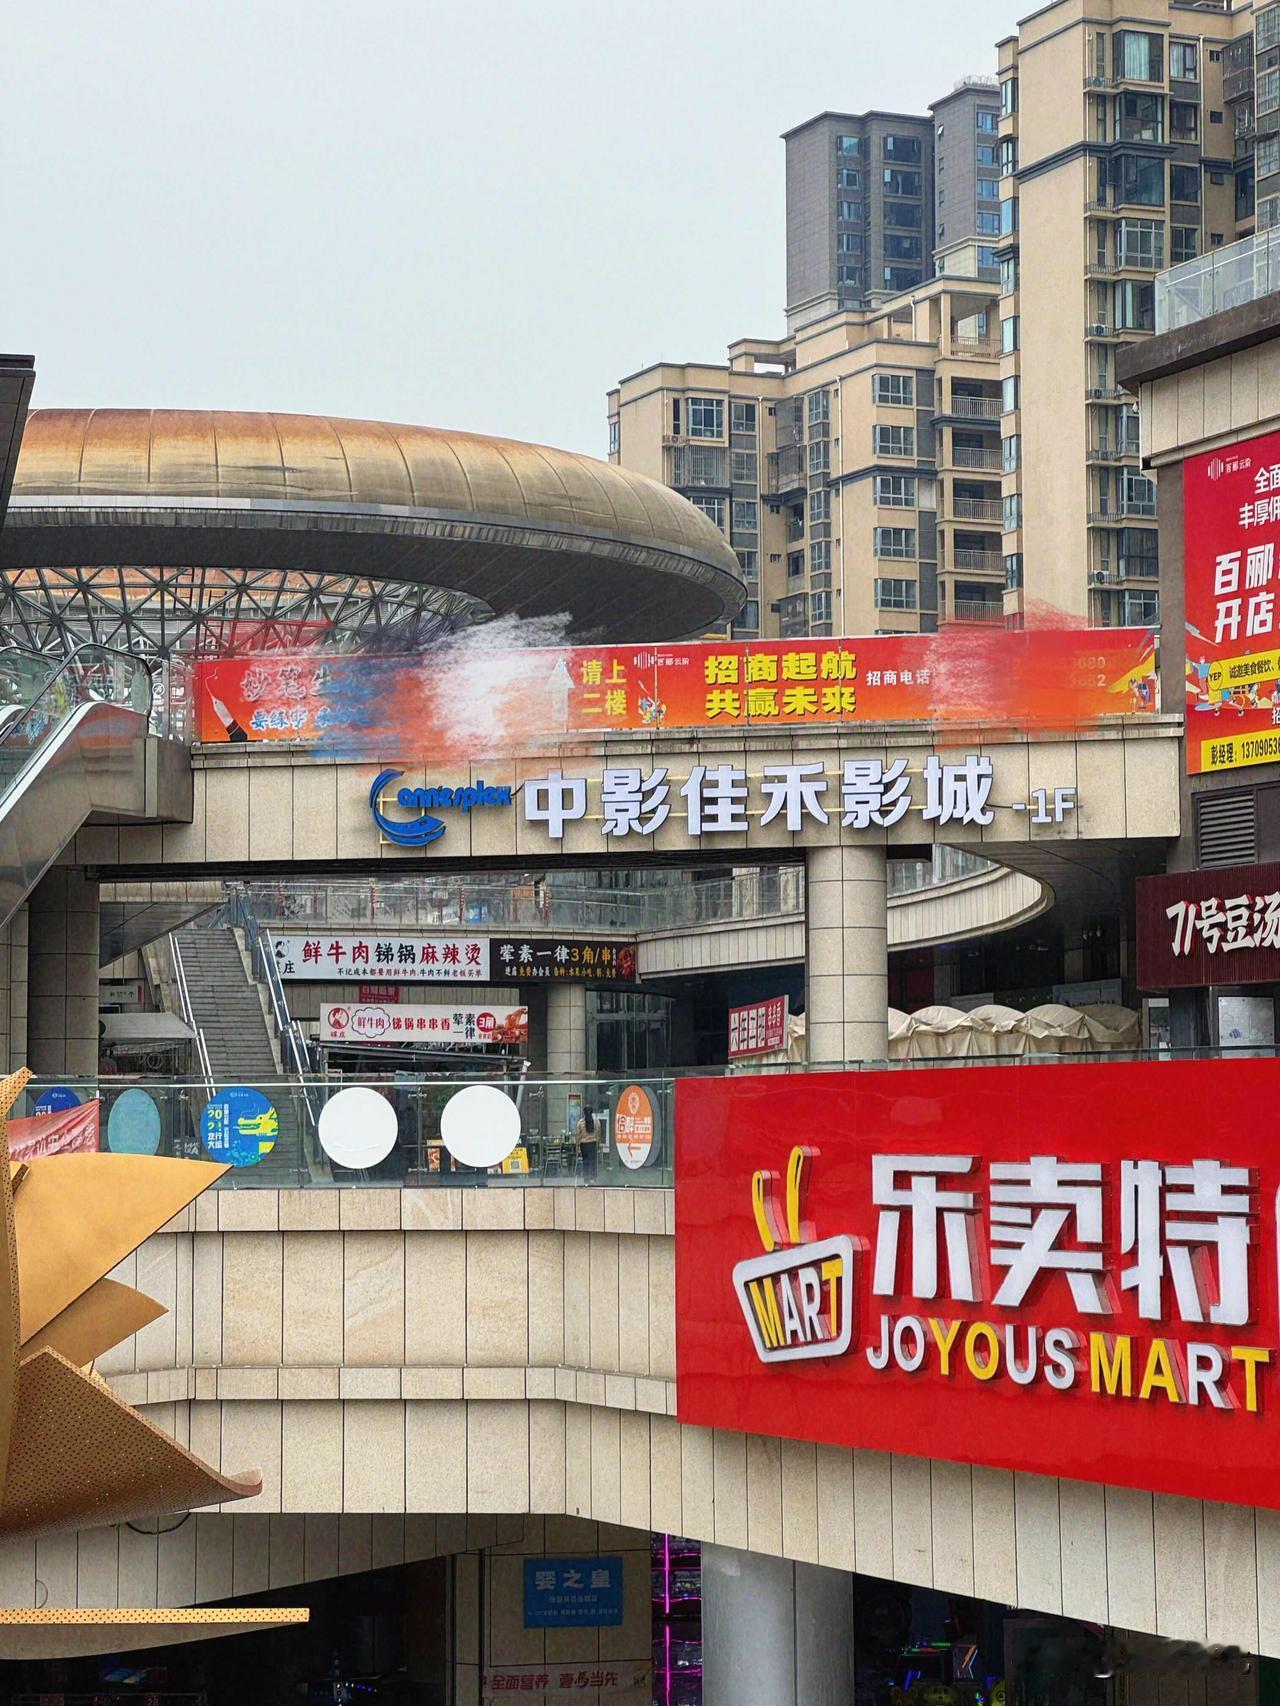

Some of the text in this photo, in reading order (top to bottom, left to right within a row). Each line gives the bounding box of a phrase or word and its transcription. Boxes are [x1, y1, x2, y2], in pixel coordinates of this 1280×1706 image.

[1214, 543, 1280, 596] 百郦
[1215, 592, 1280, 644] 开店
[580, 659, 627, 685] 请上
[704, 650, 858, 685] 招商起航
[866, 668, 931, 687] 招商电话
[1209, 671, 1222, 682] YEP
[1229, 658, 1280, 679] 诚邀美食餐饮、
[582, 689, 627, 716] 二楼
[705, 686, 858, 719] 共赢未来
[523, 755, 995, 839] 中影佳禾影城
[302, 940, 483, 966] 鲜牛肉锑锅麻辣烫
[357, 1016, 385, 1030] 鲜牛肉
[392, 1016, 451, 1031] 锑锅串串香
[872, 1154, 1254, 1326] 乐卖特
[748, 1258, 843, 1349] MART
